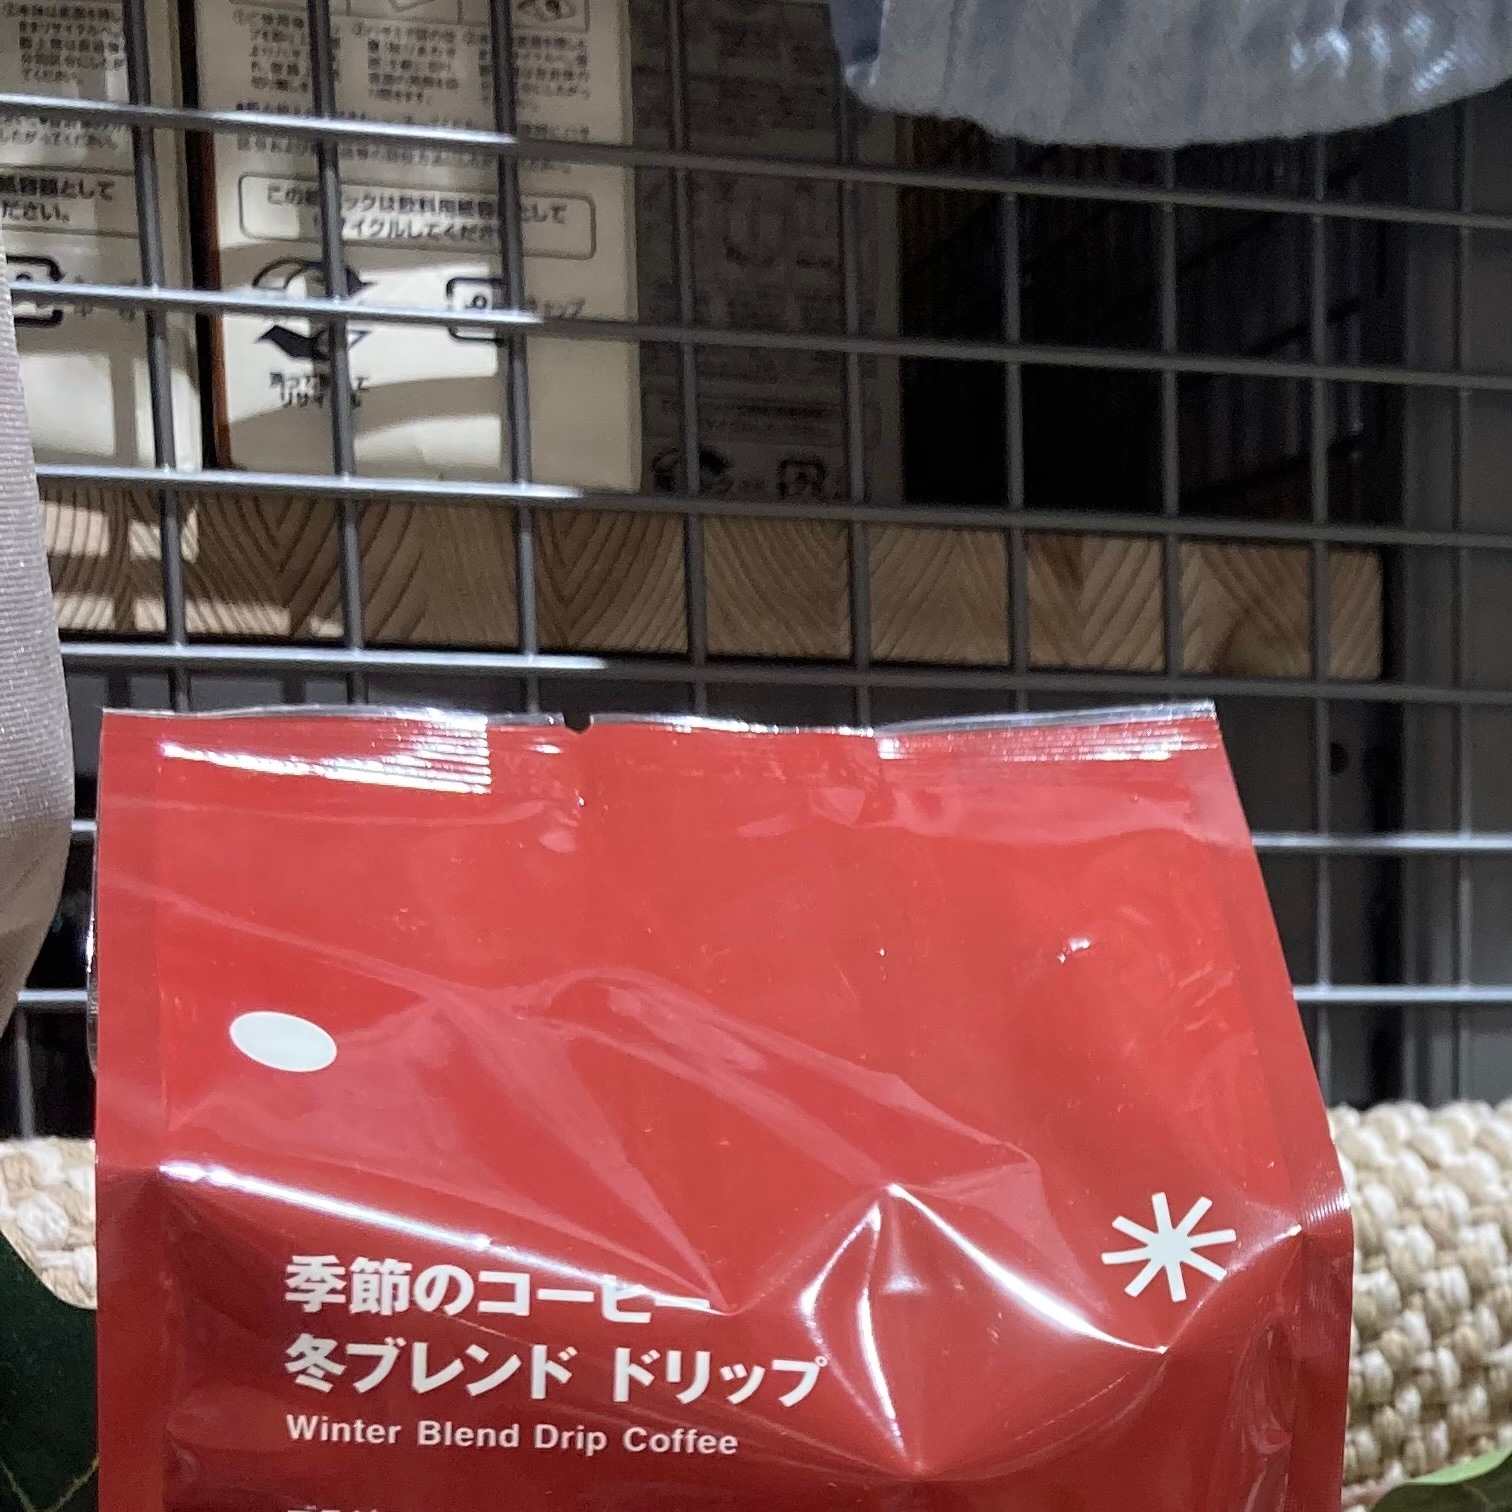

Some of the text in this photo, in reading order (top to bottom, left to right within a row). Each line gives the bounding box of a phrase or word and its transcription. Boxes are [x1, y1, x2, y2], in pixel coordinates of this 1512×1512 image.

[284, 1254, 711, 1324] 季節のコーヒー
[284, 1333, 829, 1408] 冬ブレンド ドリップ
[286, 1414, 738, 1457] Winter Blend Drip Coffee
